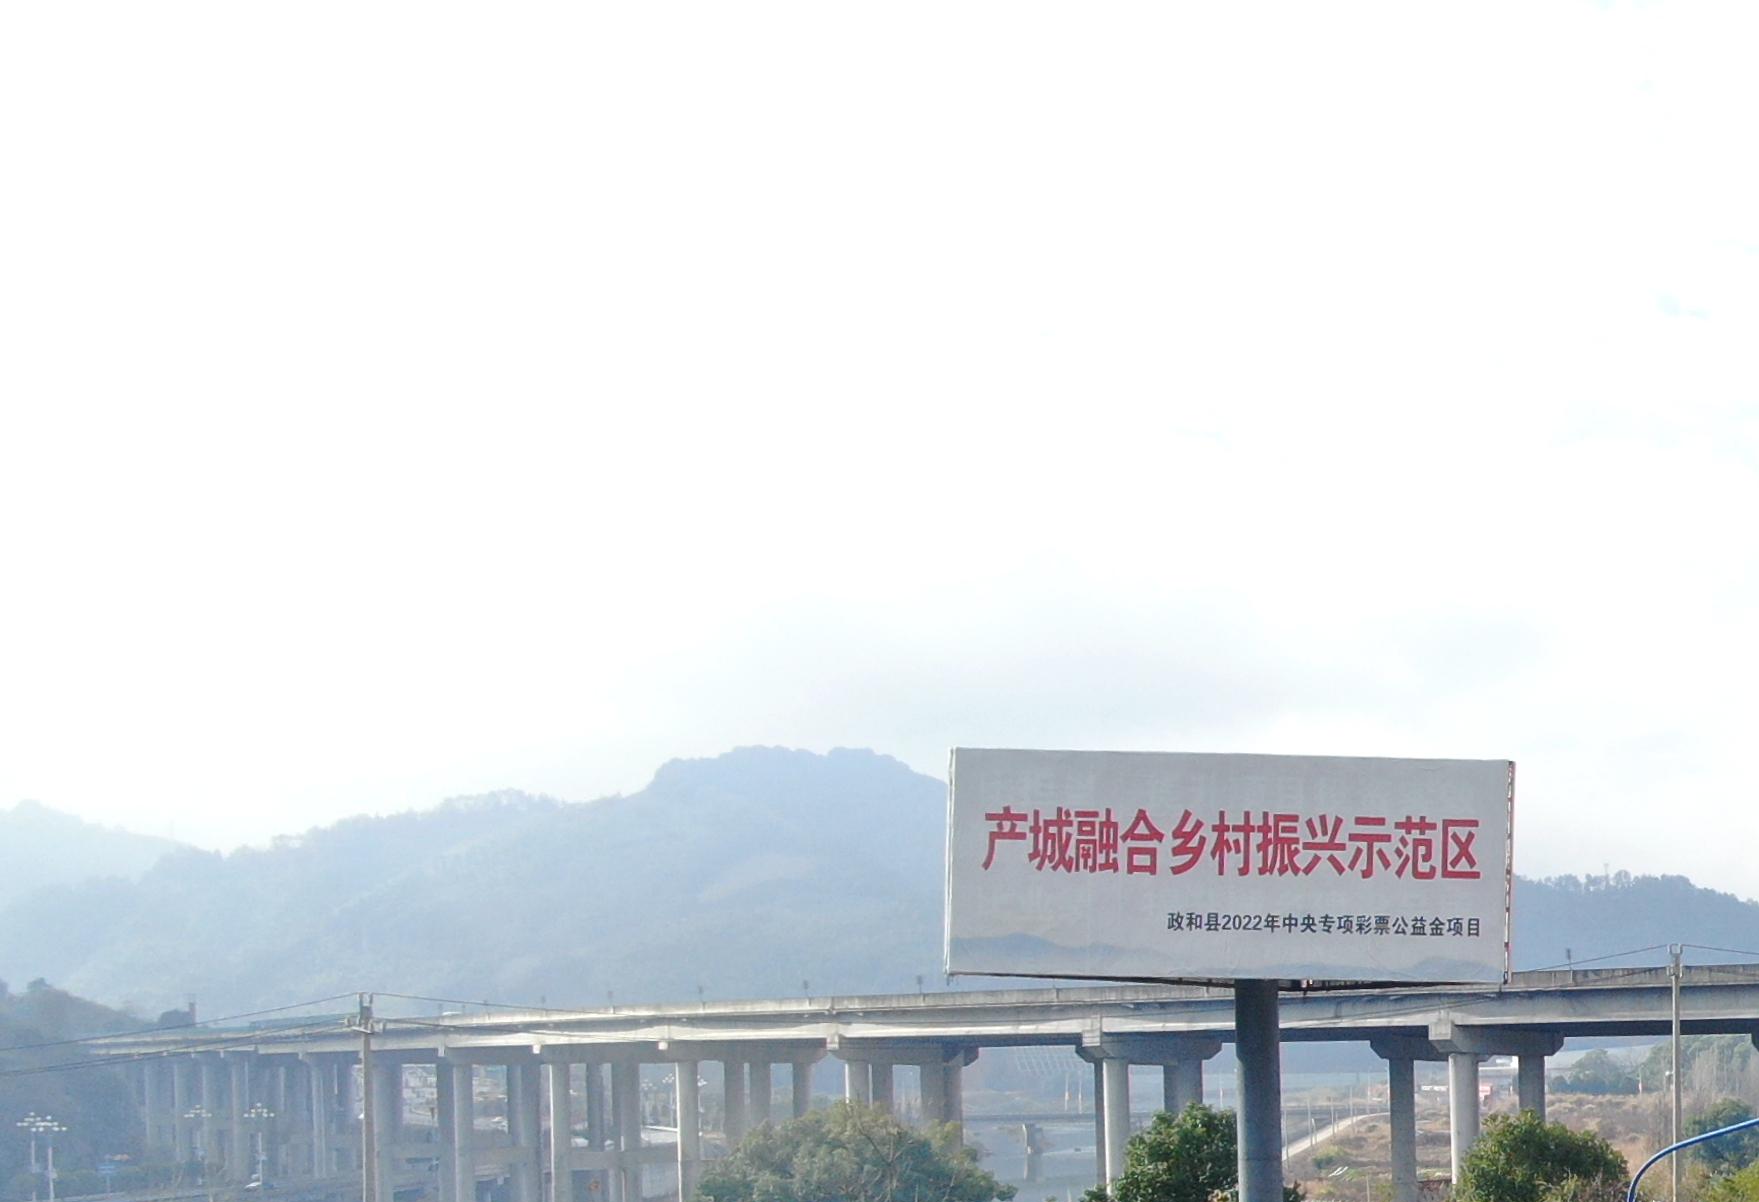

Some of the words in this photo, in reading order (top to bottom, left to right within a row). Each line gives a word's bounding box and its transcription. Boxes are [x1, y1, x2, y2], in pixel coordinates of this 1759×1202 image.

[982, 806, 1481, 880] 产城融合乡村振兴示范区
[1167, 911, 1481, 937] 政和县2022年中央专项彩票公益金项目
